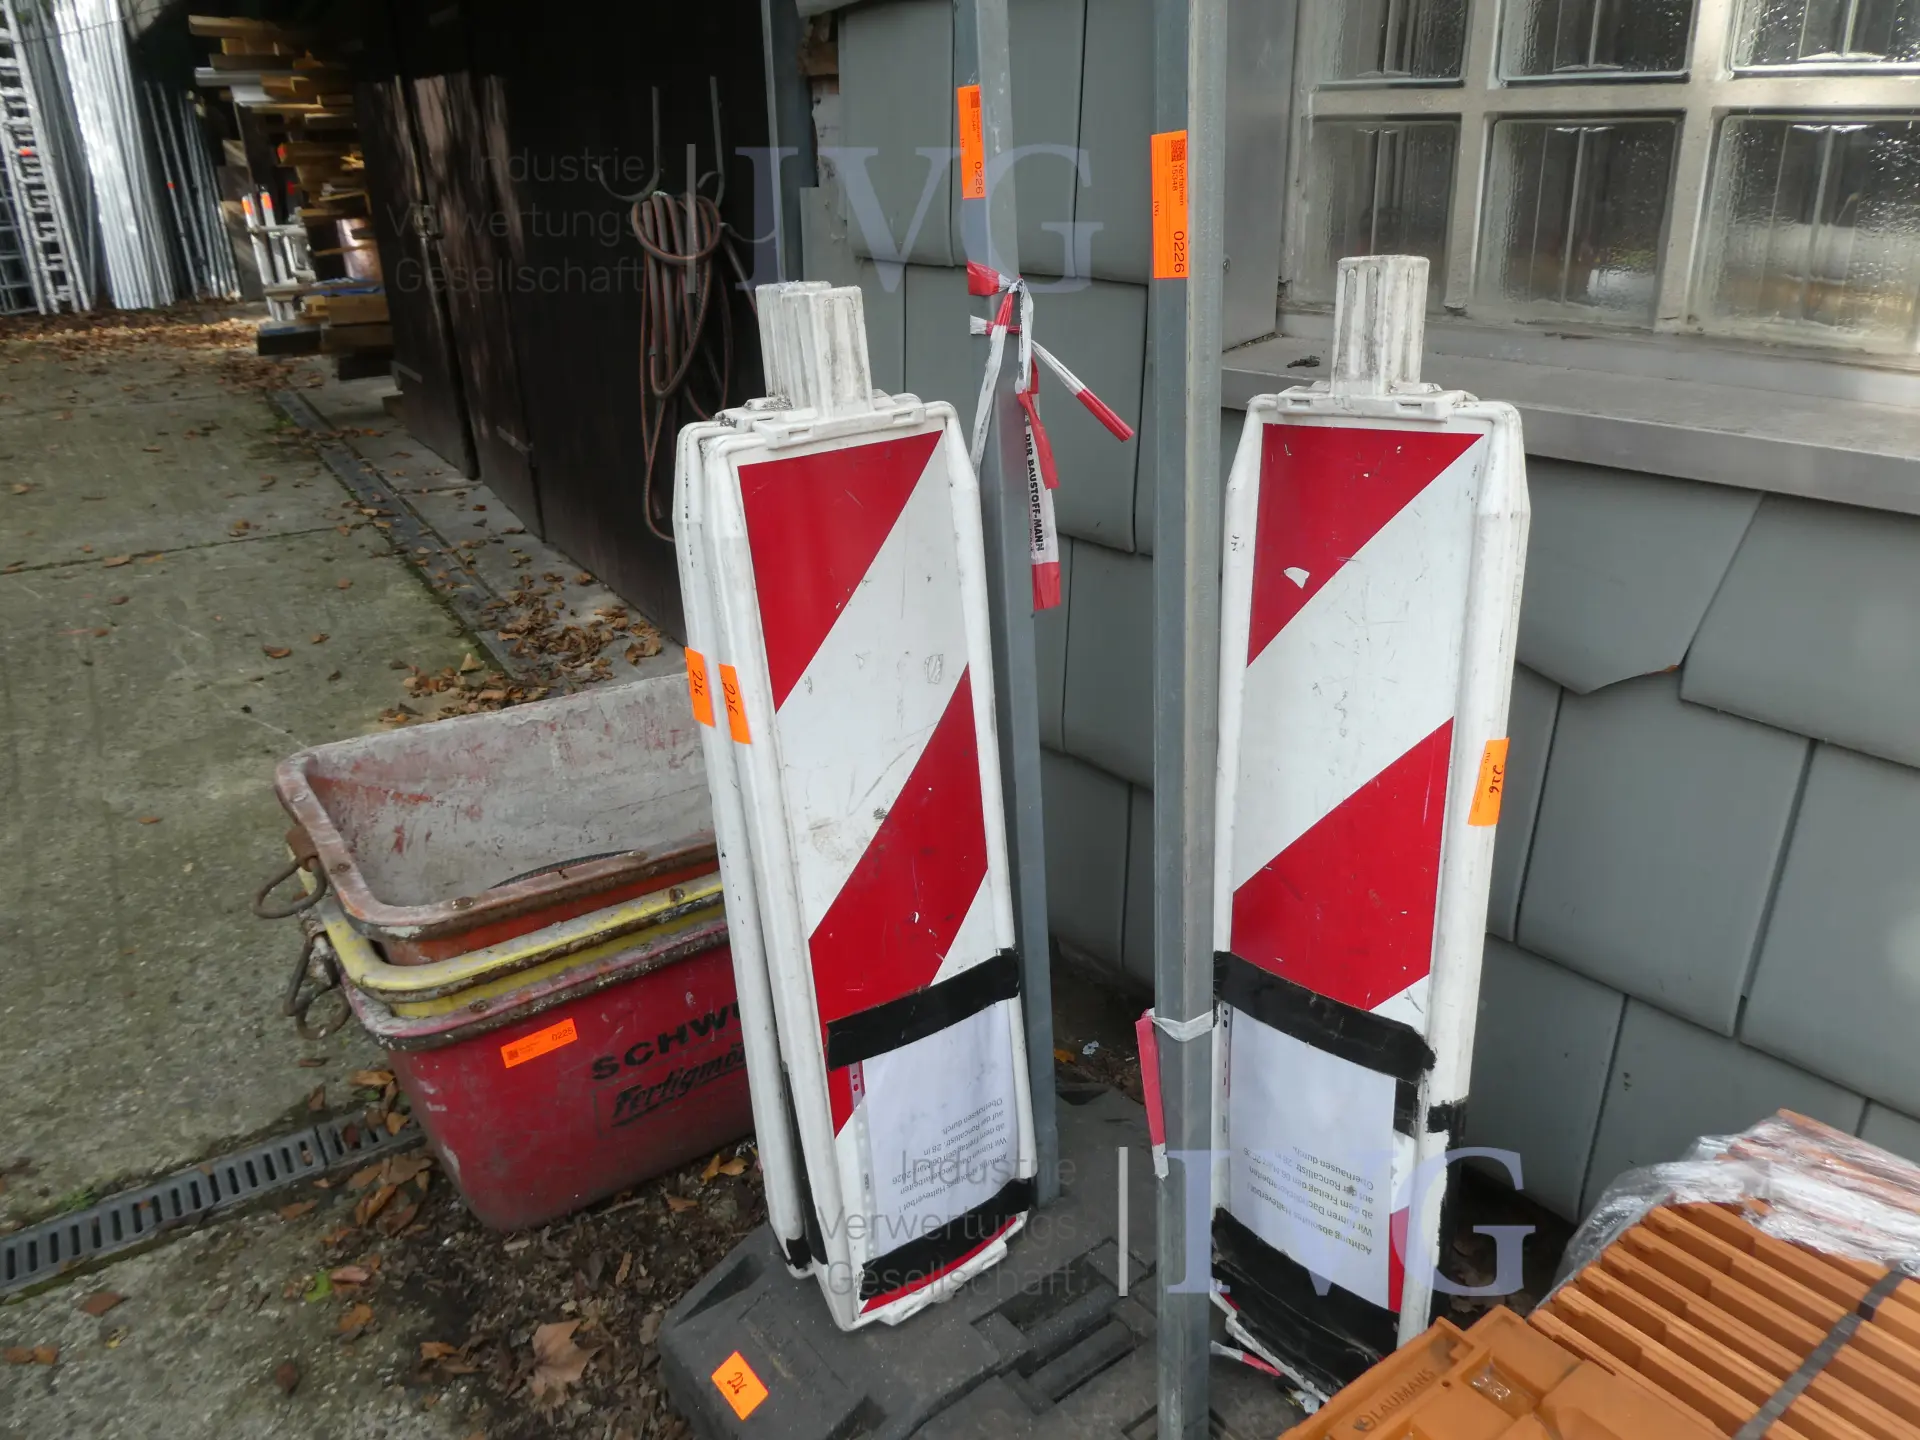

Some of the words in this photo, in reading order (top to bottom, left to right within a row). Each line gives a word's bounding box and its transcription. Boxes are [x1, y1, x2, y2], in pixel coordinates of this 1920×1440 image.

[973, 161, 984, 195] 0226
[1173, 230, 1186, 274] 0226
[1025, 432, 1034, 457] DER
[1027, 459, 1045, 552] BAUSTOFF-MANN
[1488, 764, 1504, 794] 226
[932, 1144, 942, 1152] 28
[1292, 1177, 1307, 1189] den
[1307, 1184, 1338, 1204] Freitag
[1360, 1209, 1372, 1219] ab
[1357, 1224, 1372, 1237] Wir
[1370, 1368, 1436, 1420] LAUMANS
